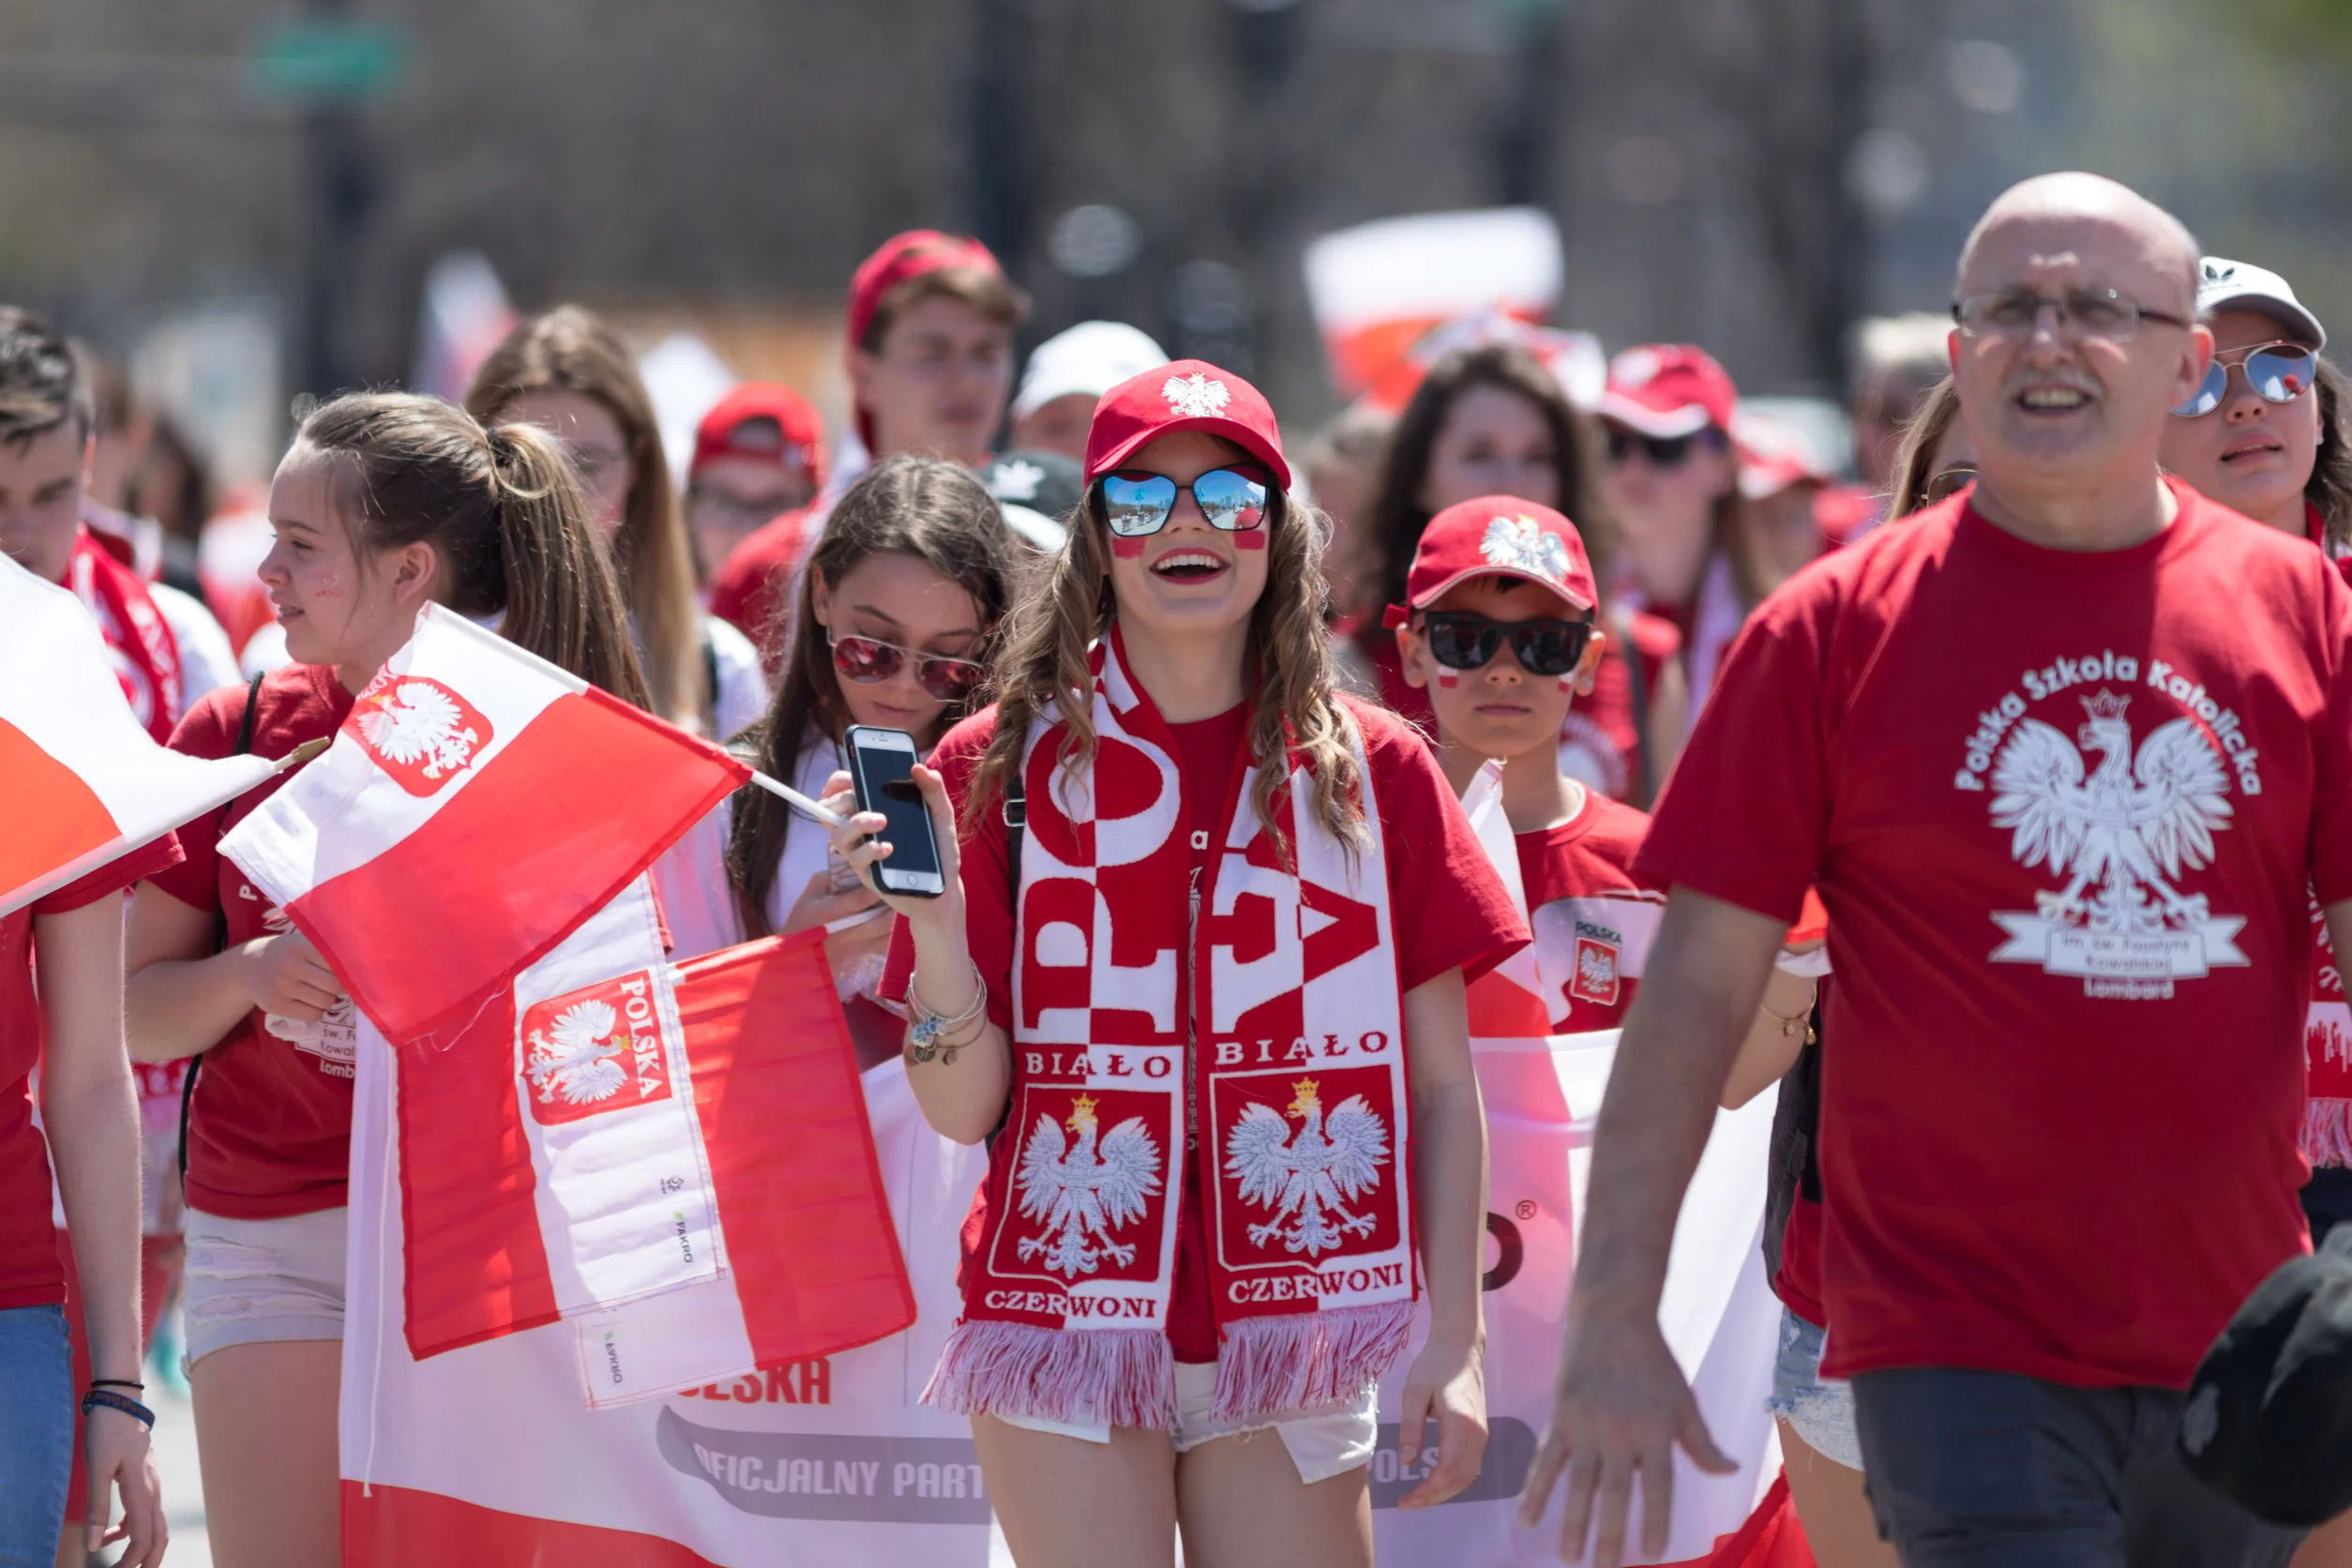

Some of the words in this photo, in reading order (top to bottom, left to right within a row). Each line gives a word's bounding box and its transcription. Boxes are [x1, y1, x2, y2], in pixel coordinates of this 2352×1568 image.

[1954, 691, 2027, 791] Polska
[2147, 658, 2261, 795] Katolicka
[1576, 921, 1621, 943] POLSKA
[2083, 975, 2175, 1001] Lombard
[620, 977, 662, 1098] POLSKA
[1214, 1031, 1389, 1065] BIAŁO
[1025, 1051, 1171, 1079] BIAŁO
[675, 1221, 693, 1264] FAKRO
[1228, 1262, 1404, 1304] CZERWONI
[985, 1289, 1156, 1318] CZERWONI
[1366, 1446, 1440, 1484] OLS
